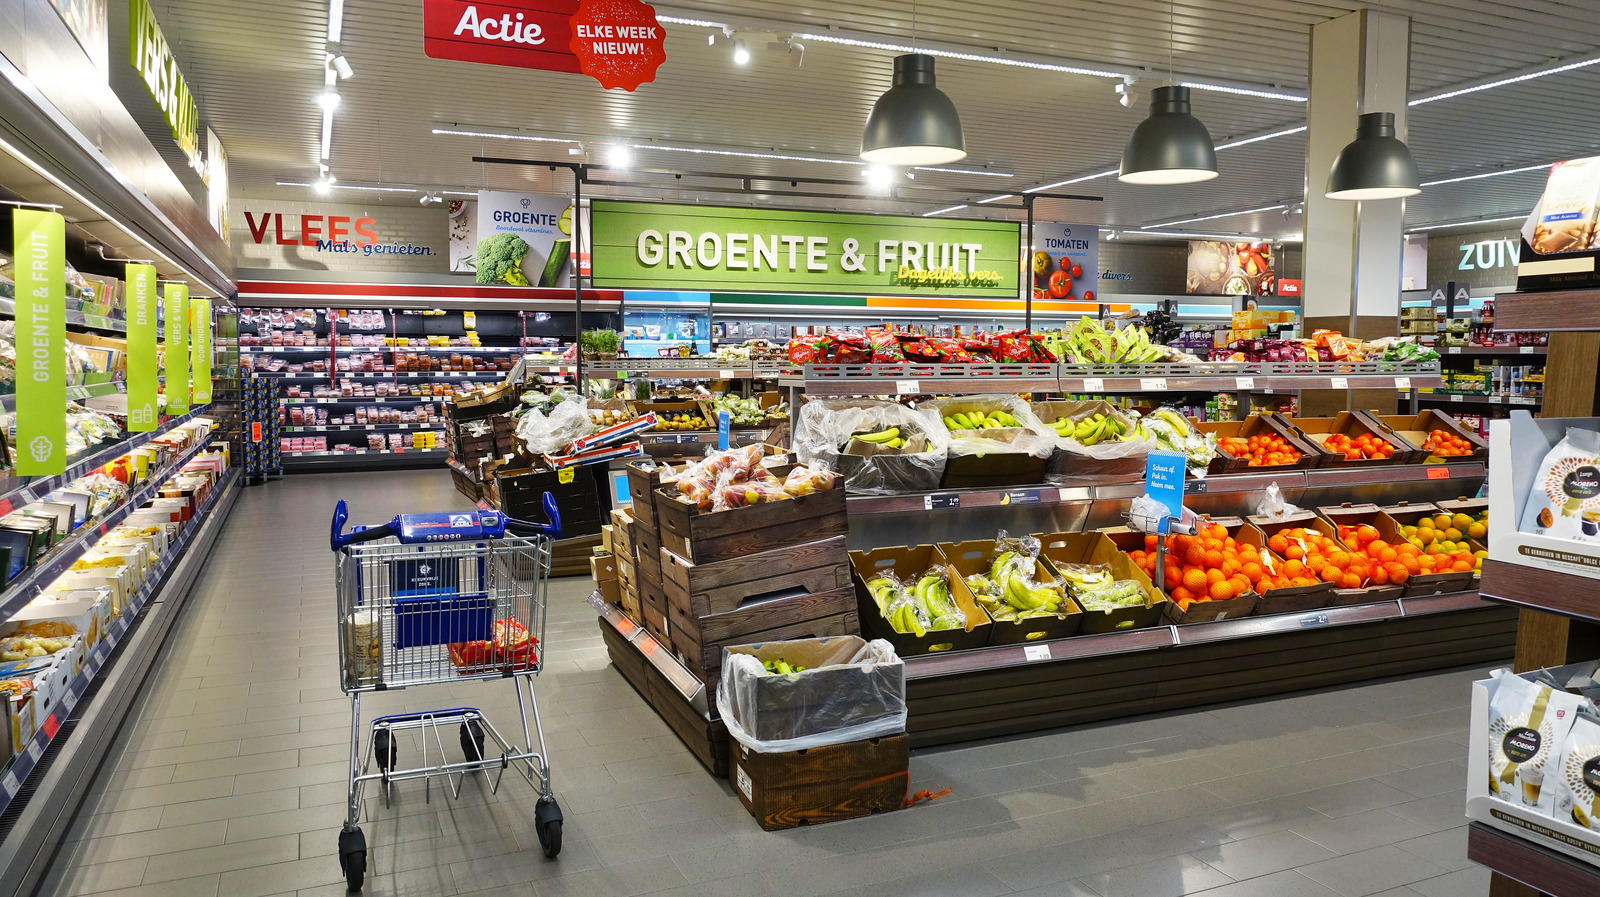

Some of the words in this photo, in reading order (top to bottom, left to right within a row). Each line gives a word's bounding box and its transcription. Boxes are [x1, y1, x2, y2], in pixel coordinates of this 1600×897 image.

[453, 5, 546, 45] Actie
[576, 24, 614, 39] ELKE
[617, 25, 658, 40] WEEK
[592, 41, 645, 56] NIEUW!
[493, 210, 557, 227] GROENTE
[243, 211, 379, 249] VLEES
[317, 239, 359, 254] Mals
[363, 241, 437, 257] genieten.
[637, 229, 829, 271] GROENTE
[840, 237, 868, 272] &
[878, 239, 983, 275] FRUIT
[1044, 238, 1089, 250] TOMATEN
[31, 231, 49, 282] FRUIT
[1458, 240, 1520, 271] ZUIV
[898, 264, 966, 284] Dagelijks
[969, 268, 1004, 281] vers.
[1101, 269, 1134, 281] divers.
[32, 284, 49, 299] &
[1282, 283, 1298, 292] Actie
[136, 273, 147, 325] DRANKEN
[172, 291, 182, 313] VLUG
[172, 313, 182, 321] &
[32, 302, 50, 382] GROENTE
[172, 323, 182, 346] VERS
[1151, 472, 1161, 480] Pak
[1152, 463, 1169, 473] Scheur
[1150, 481, 1164, 489] Neem
[1163, 482, 1176, 490] mee.
[1569, 480, 1599, 488] MORENO
[1509, 739, 1536, 751] MORENO
